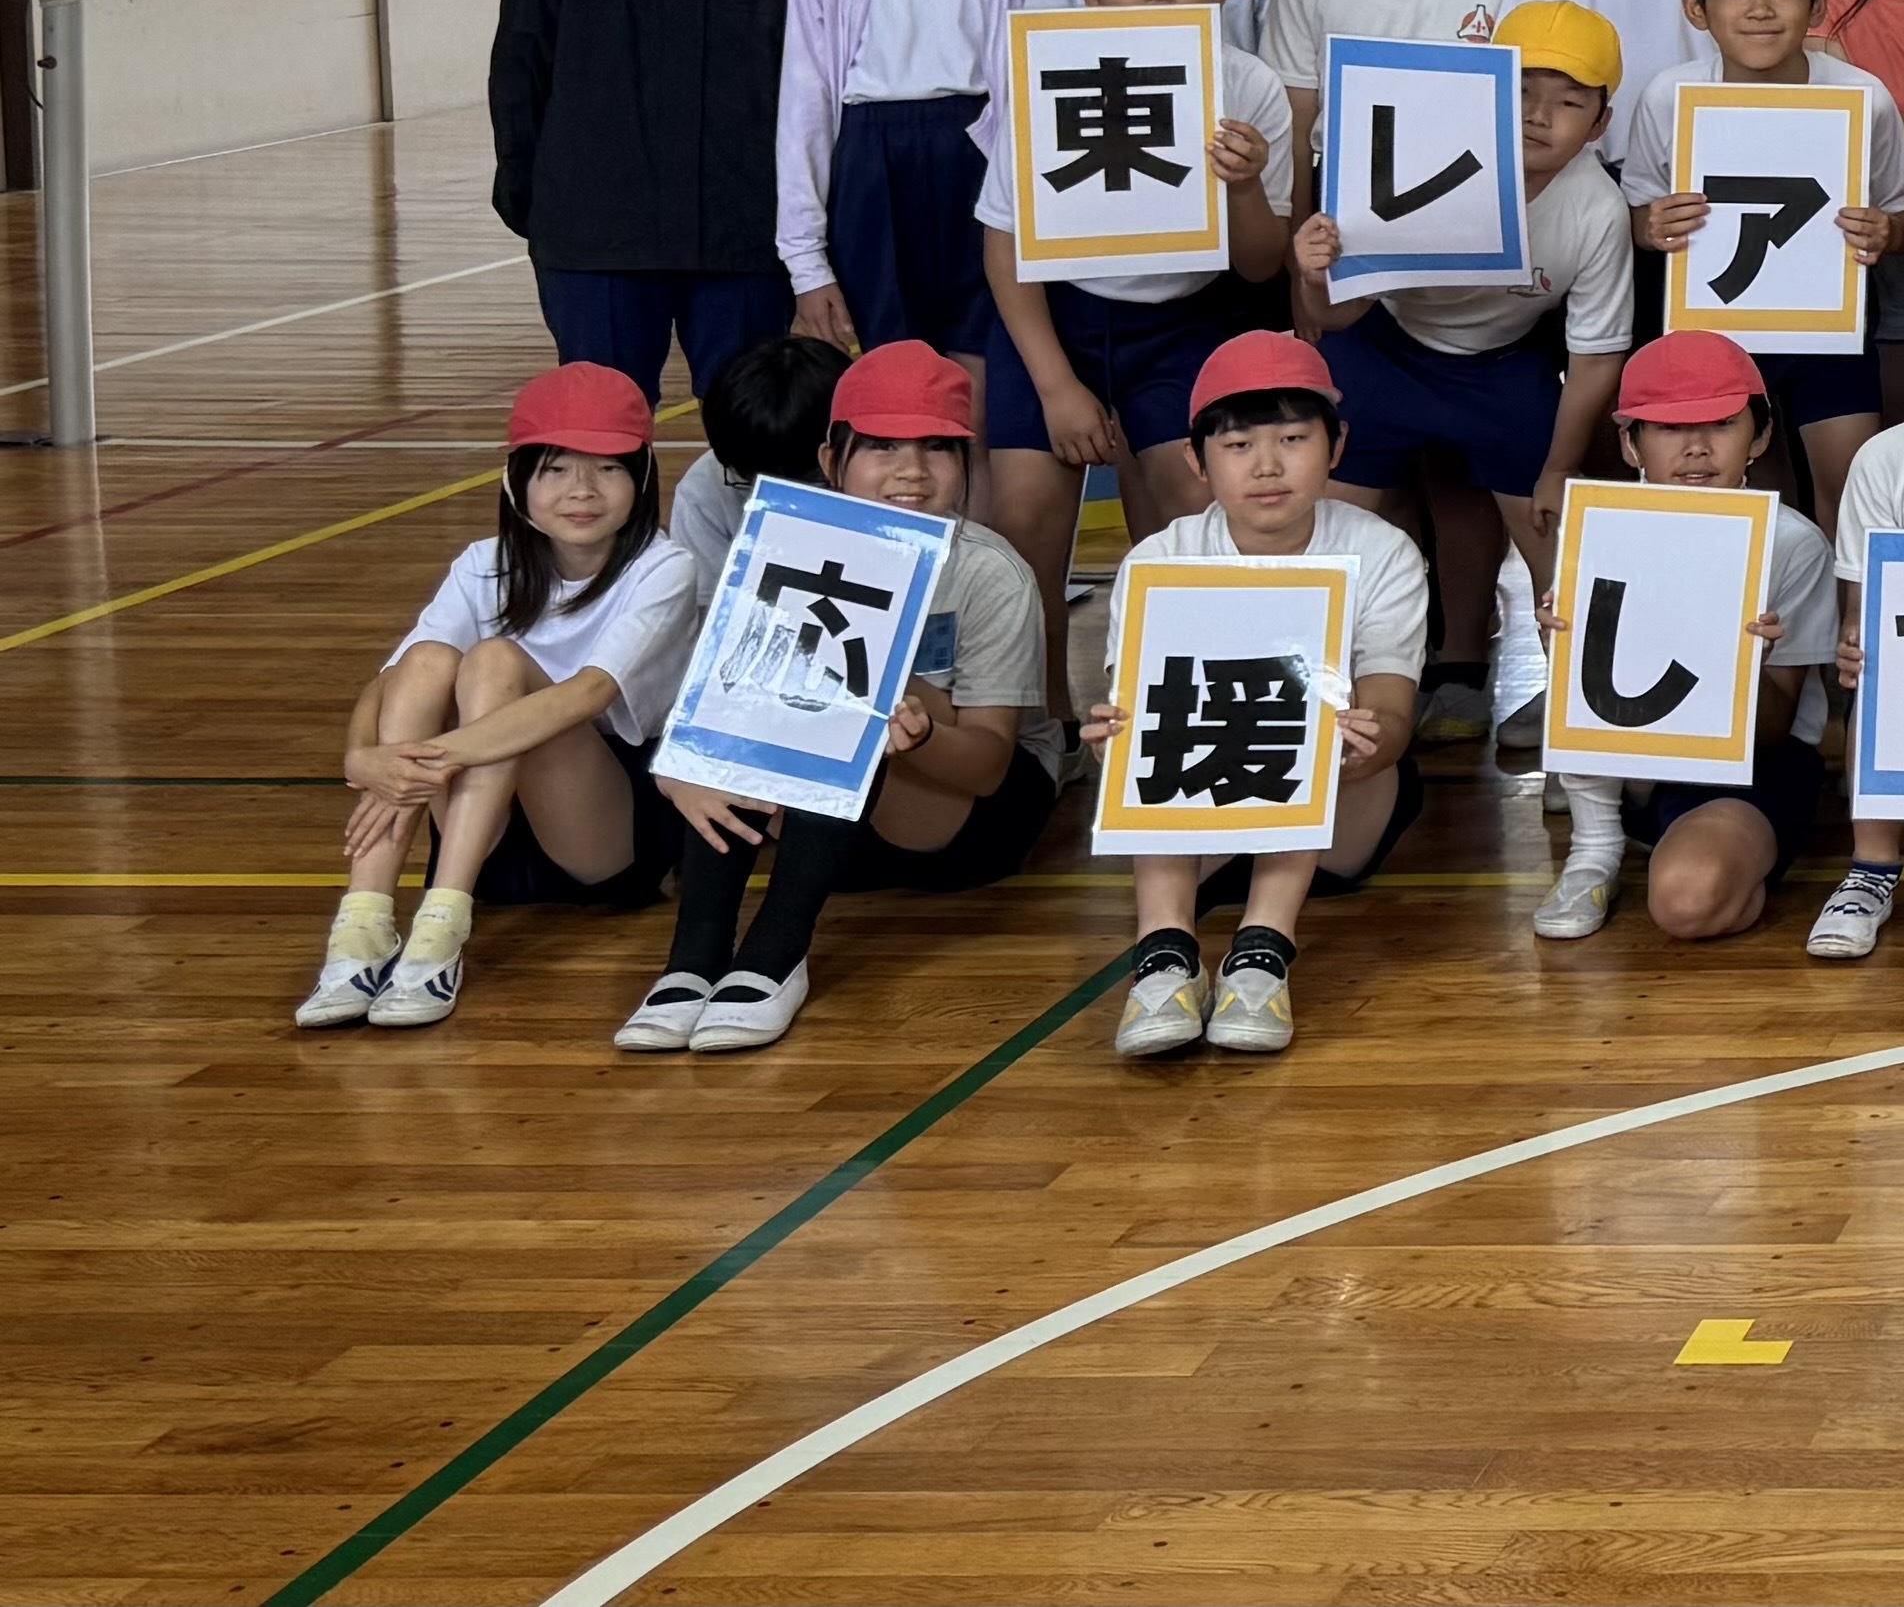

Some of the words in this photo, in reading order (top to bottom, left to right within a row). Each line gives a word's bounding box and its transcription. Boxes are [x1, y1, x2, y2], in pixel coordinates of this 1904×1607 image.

[1040, 55, 1193, 194] 東
[1369, 104, 1485, 223] レ
[1703, 174, 1832, 305] ア
[718, 560, 894, 714] 応
[1580, 576, 1700, 728] し
[1135, 653, 1309, 807] 援
